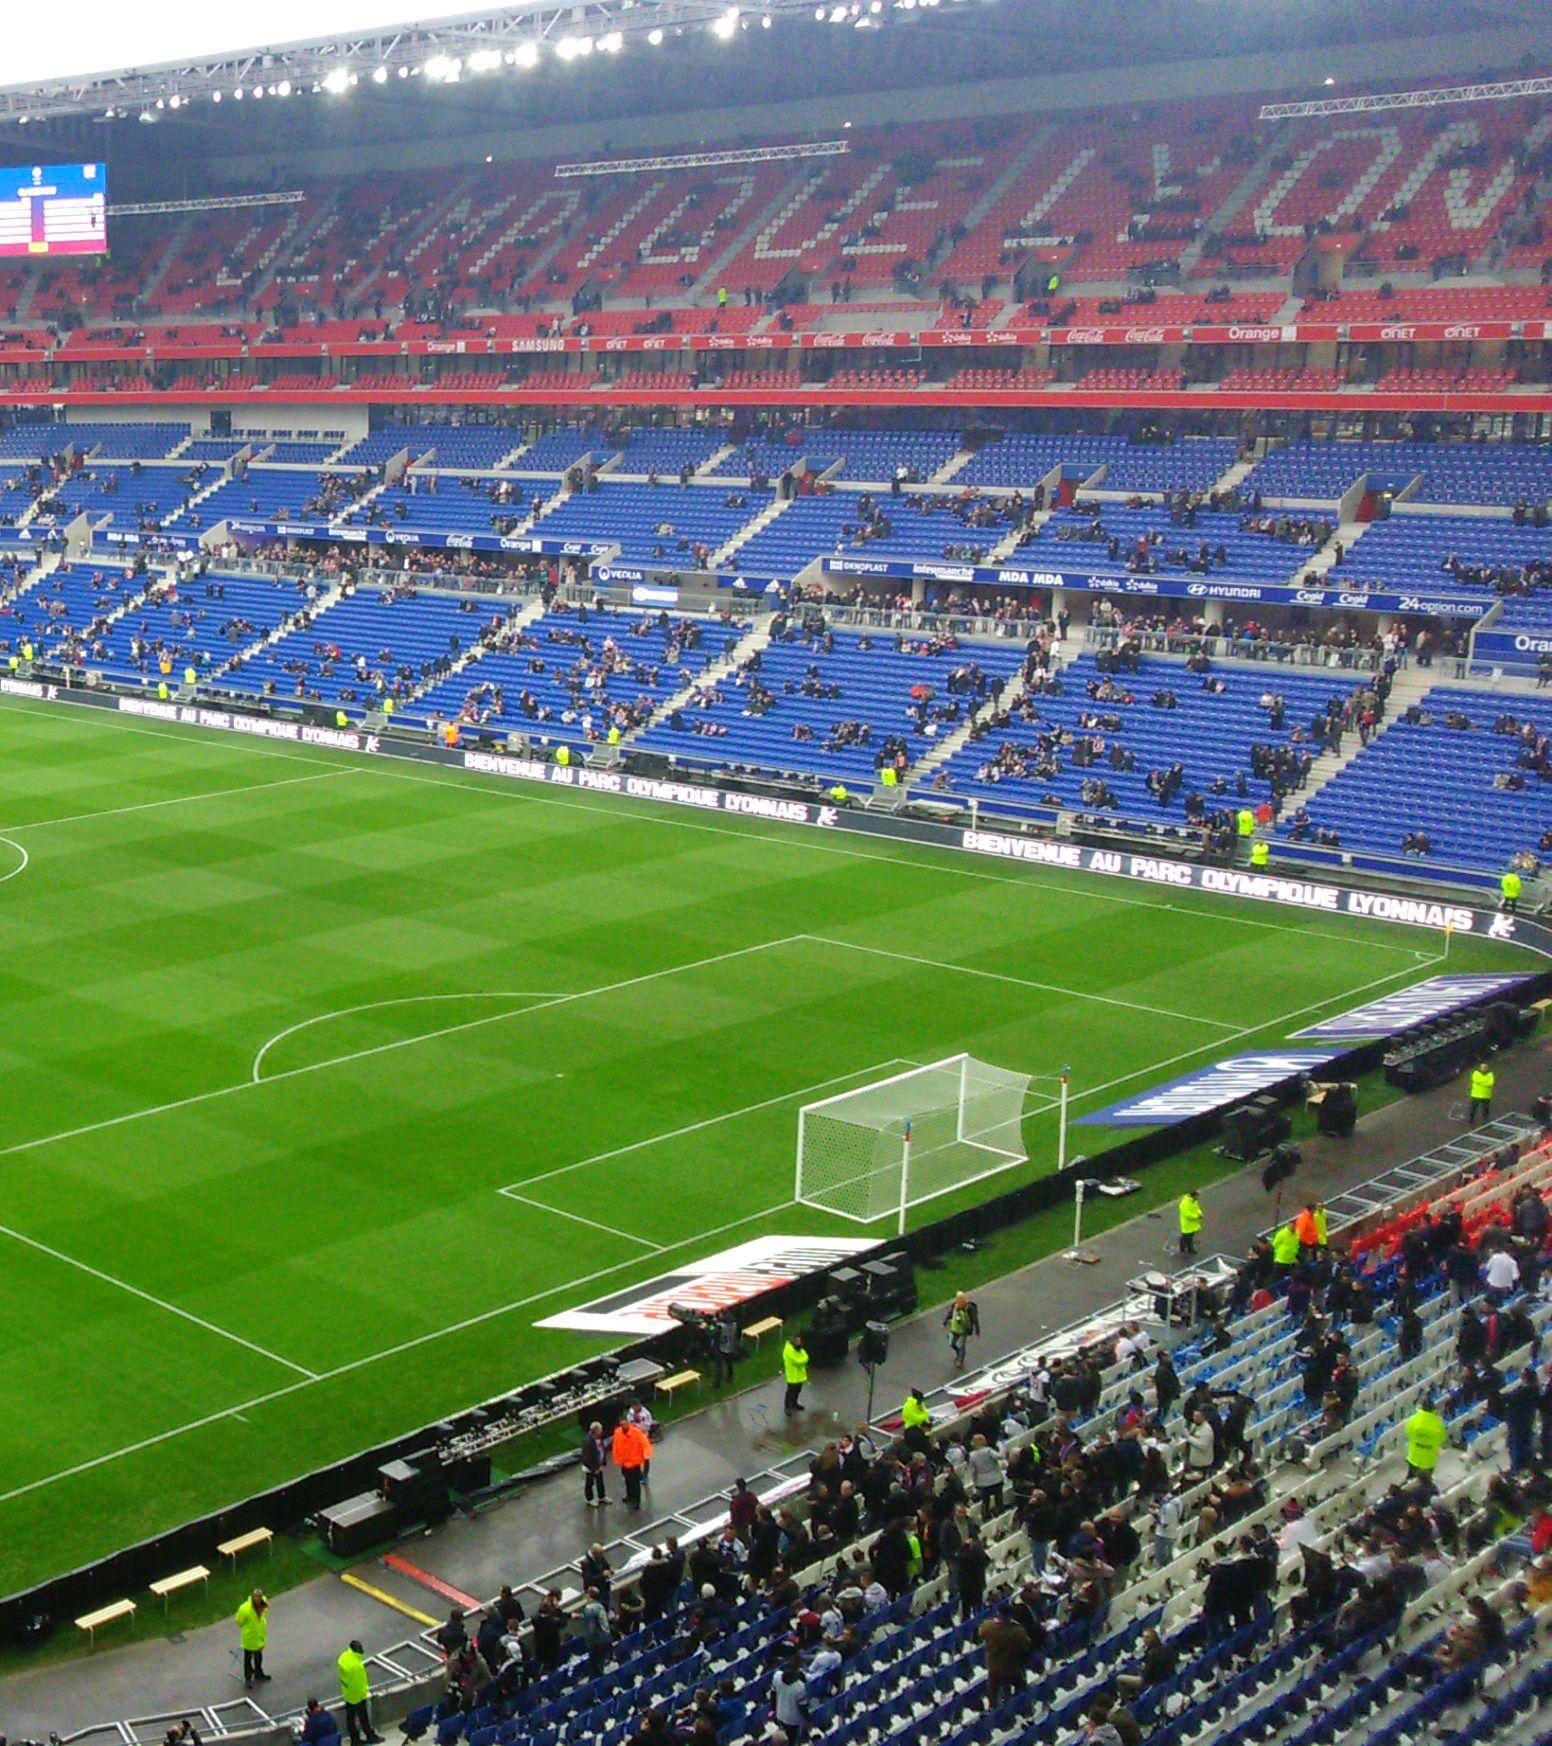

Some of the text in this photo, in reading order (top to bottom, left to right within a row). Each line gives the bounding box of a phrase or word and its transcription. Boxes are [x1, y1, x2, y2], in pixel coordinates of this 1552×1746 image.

[1228, 327, 1280, 340] Orange
[512, 340, 565, 352] SAMSUNG
[500, 538, 532, 551] Orange
[609, 571, 643, 581] VEOLIA
[998, 571, 1064, 586] MDA MDA
[1208, 586, 1262, 599] HYUNDAI
[1295, 590, 1369, 606] Cegid Cegid
[1514, 635, 1552, 653] Ora
[180, 707, 197, 722] AU
[200, 711, 230, 728] PARC
[464, 752, 809, 823] BIENVENUE AU PARC OLYMPIQUE LYONNAIS
[962, 830, 1473, 931] BIENVENUE AU PARC OLYMPIQUE LYONNAIS
